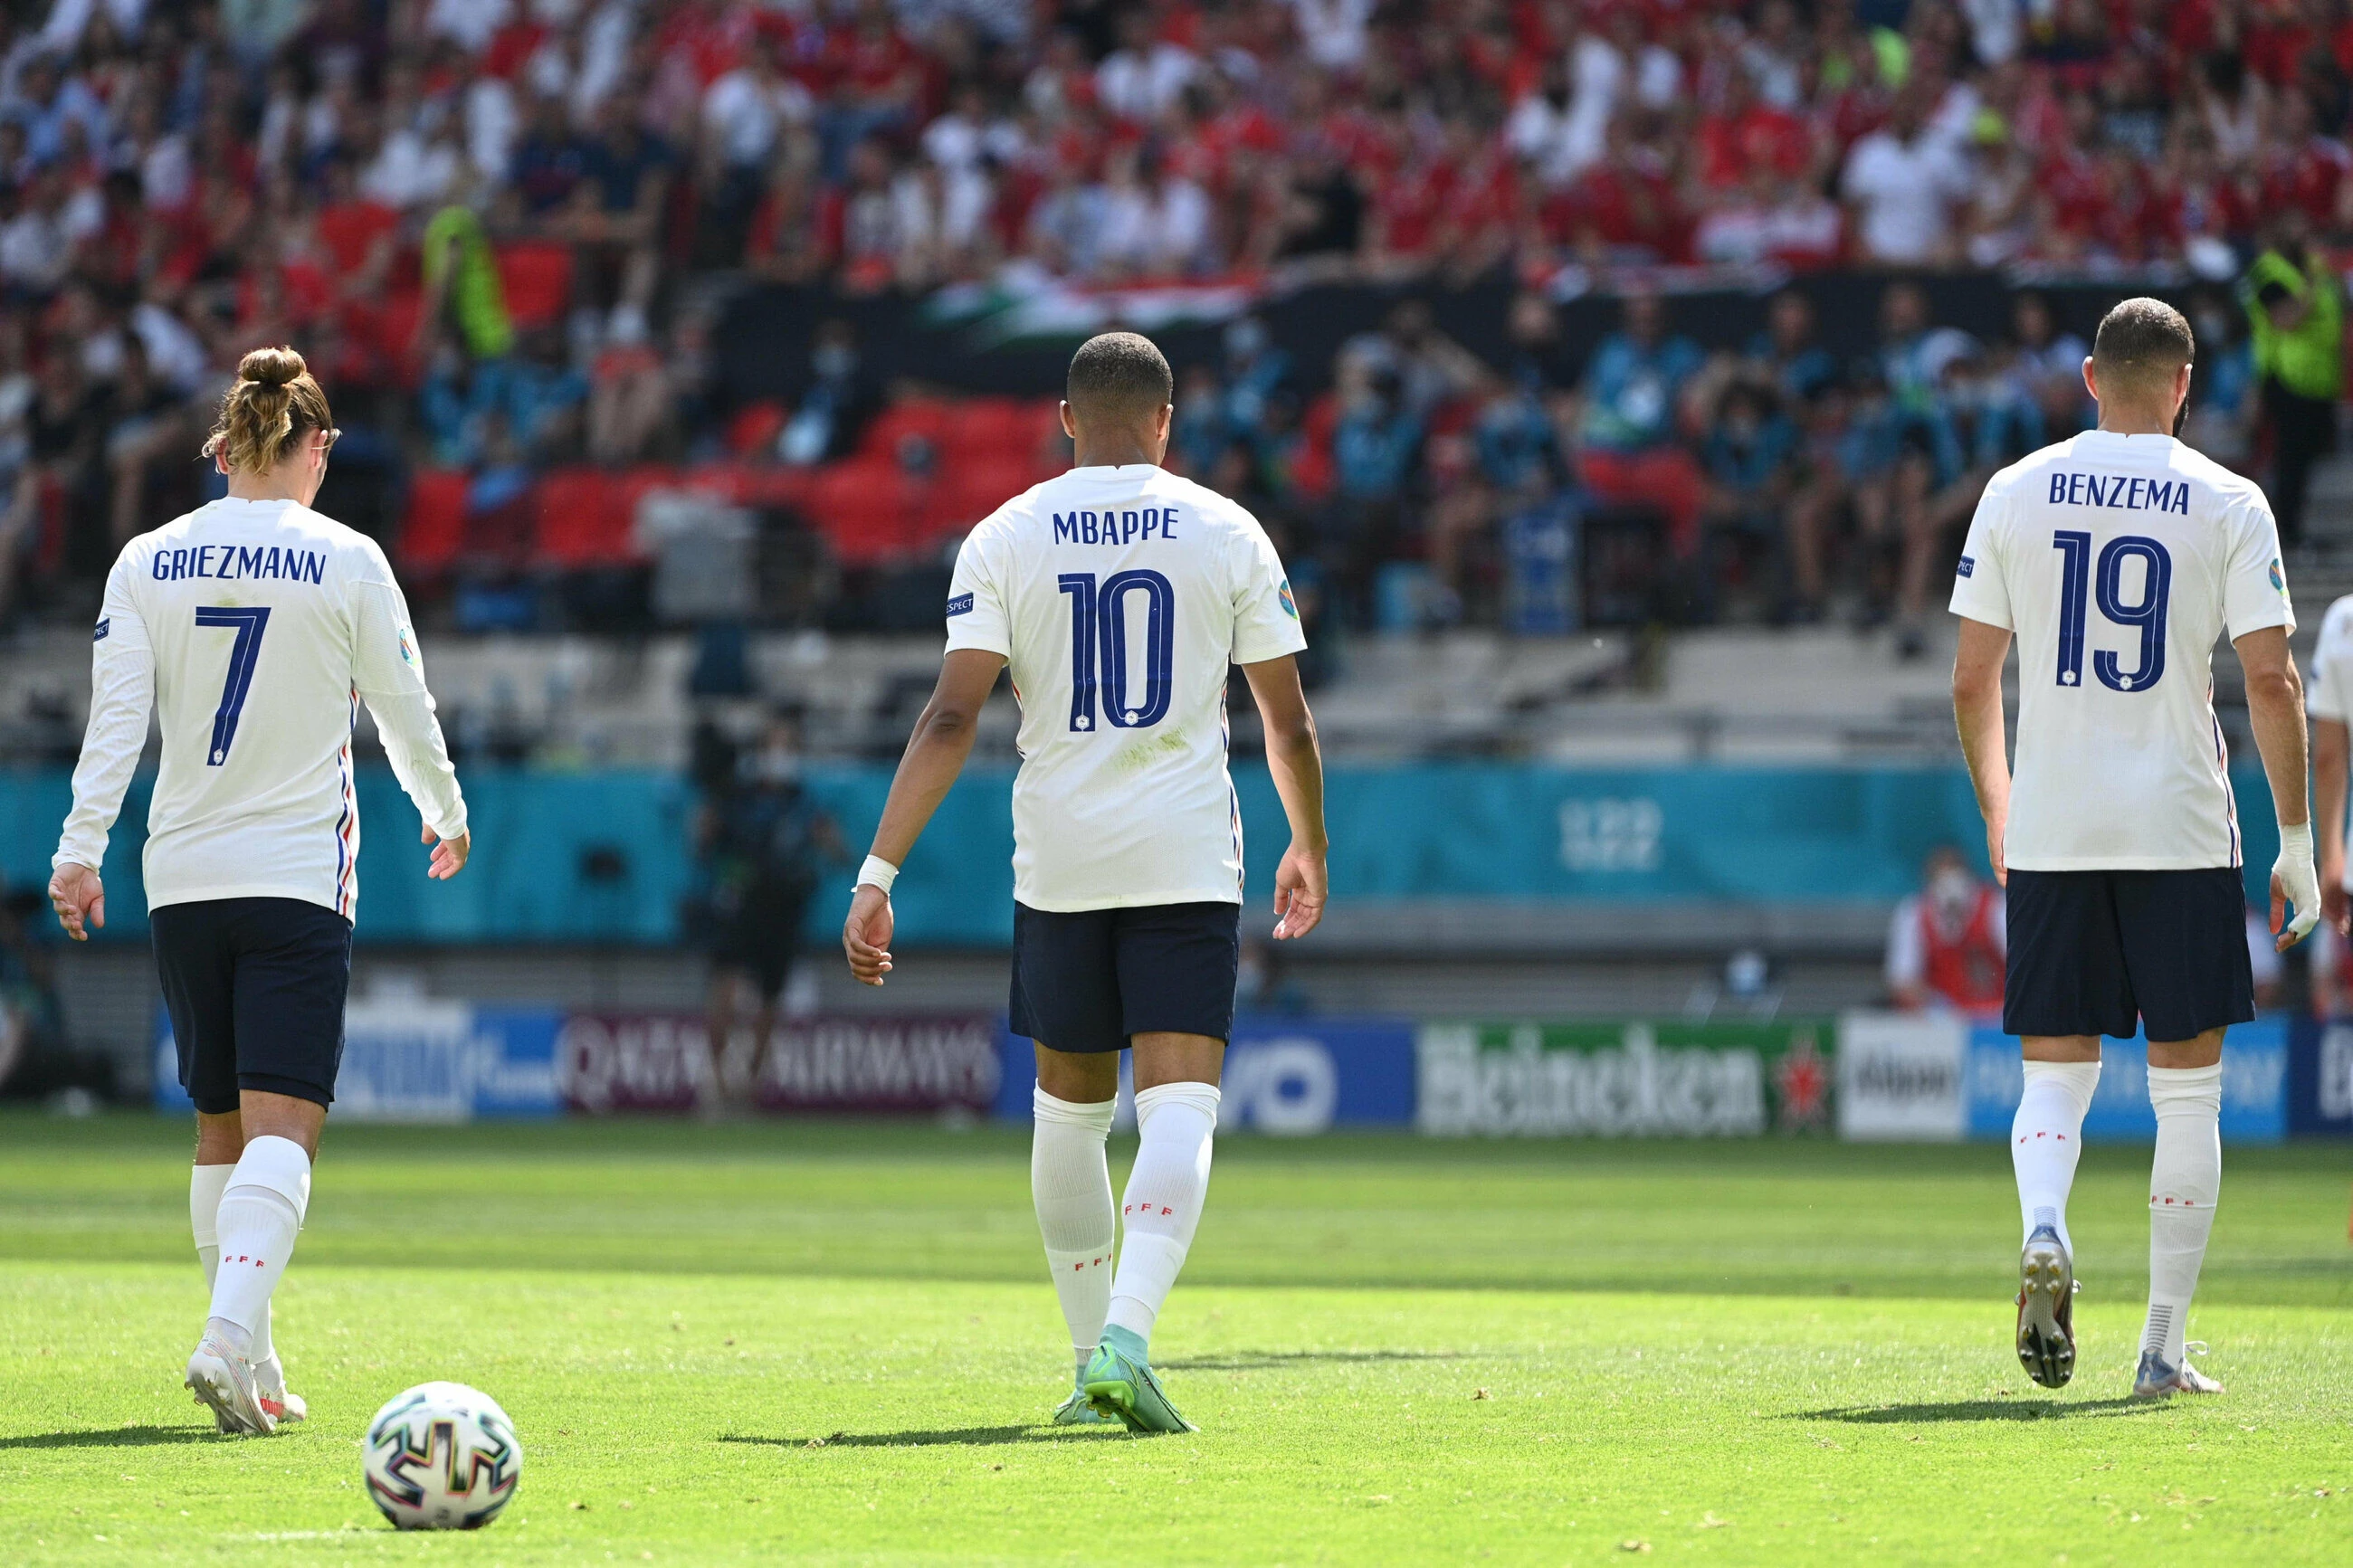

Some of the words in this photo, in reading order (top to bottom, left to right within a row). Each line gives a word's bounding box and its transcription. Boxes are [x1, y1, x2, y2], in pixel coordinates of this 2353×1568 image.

[1053, 508, 1178, 545] MBAPPE
[2050, 474, 2188, 515] BENZEMA
[153, 546, 326, 584] GRIEZMANN
[947, 598, 973, 613] SPECT
[2053, 530, 2171, 691] 19
[195, 607, 271, 765] 7
[1058, 569, 1174, 731] 10
[1419, 1024, 1763, 1135] Heineken
